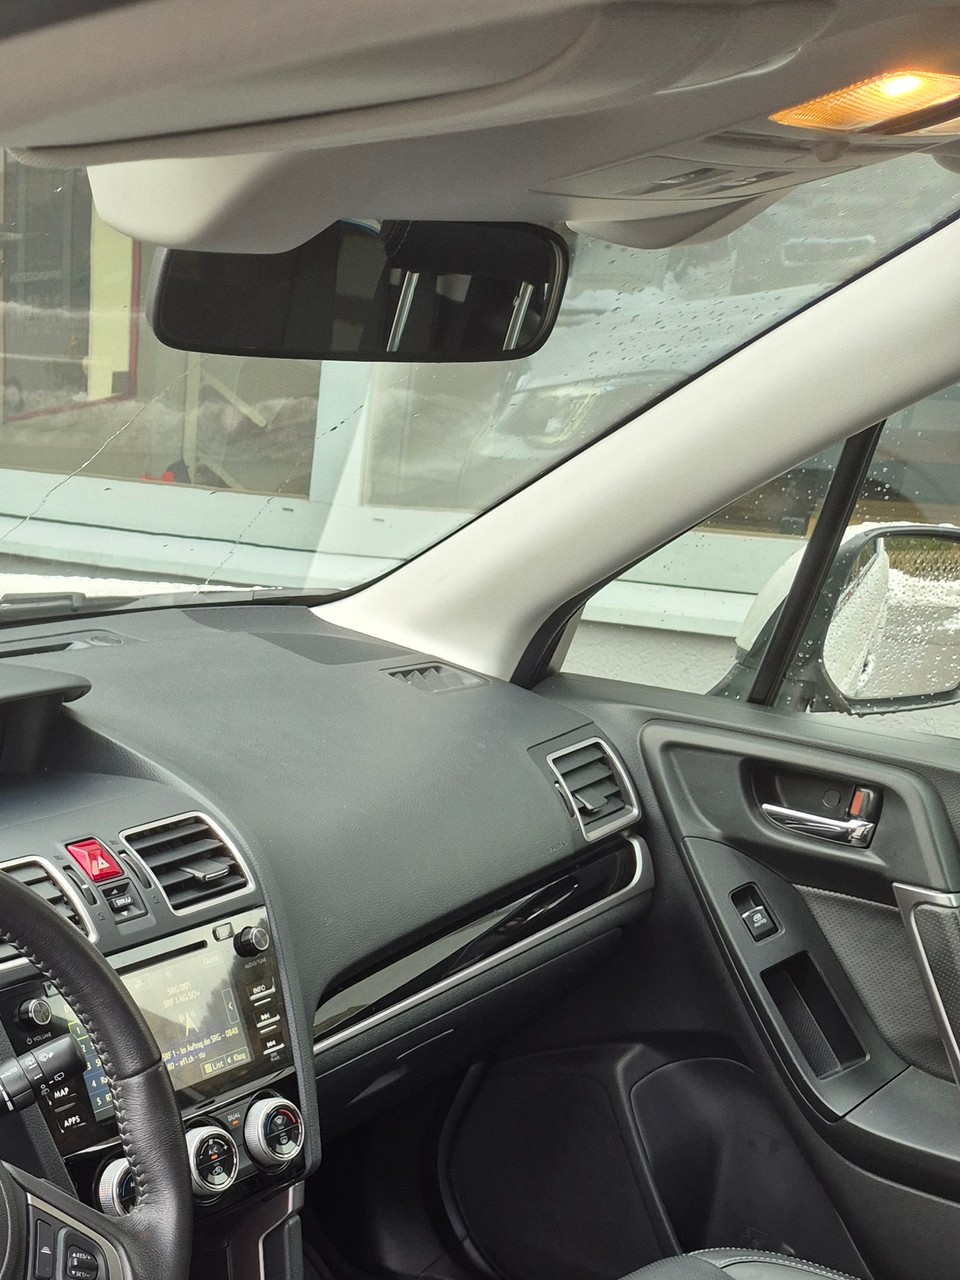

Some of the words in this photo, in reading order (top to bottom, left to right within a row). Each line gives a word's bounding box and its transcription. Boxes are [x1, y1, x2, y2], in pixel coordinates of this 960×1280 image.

[167, 983, 181, 995] SRG
[252, 985, 266, 994] INFO
[162, 997, 175, 1008] SRF
[178, 994, 189, 1004] AG
[33, 1032, 52, 1042] VOLUME
[212, 1061, 224, 1070] List
[54, 1087, 69, 1098] MAP
[64, 1115, 81, 1127] APPS
[227, 1112, 241, 1122] DUAL
[208, 1146, 218, 1155] A/C
